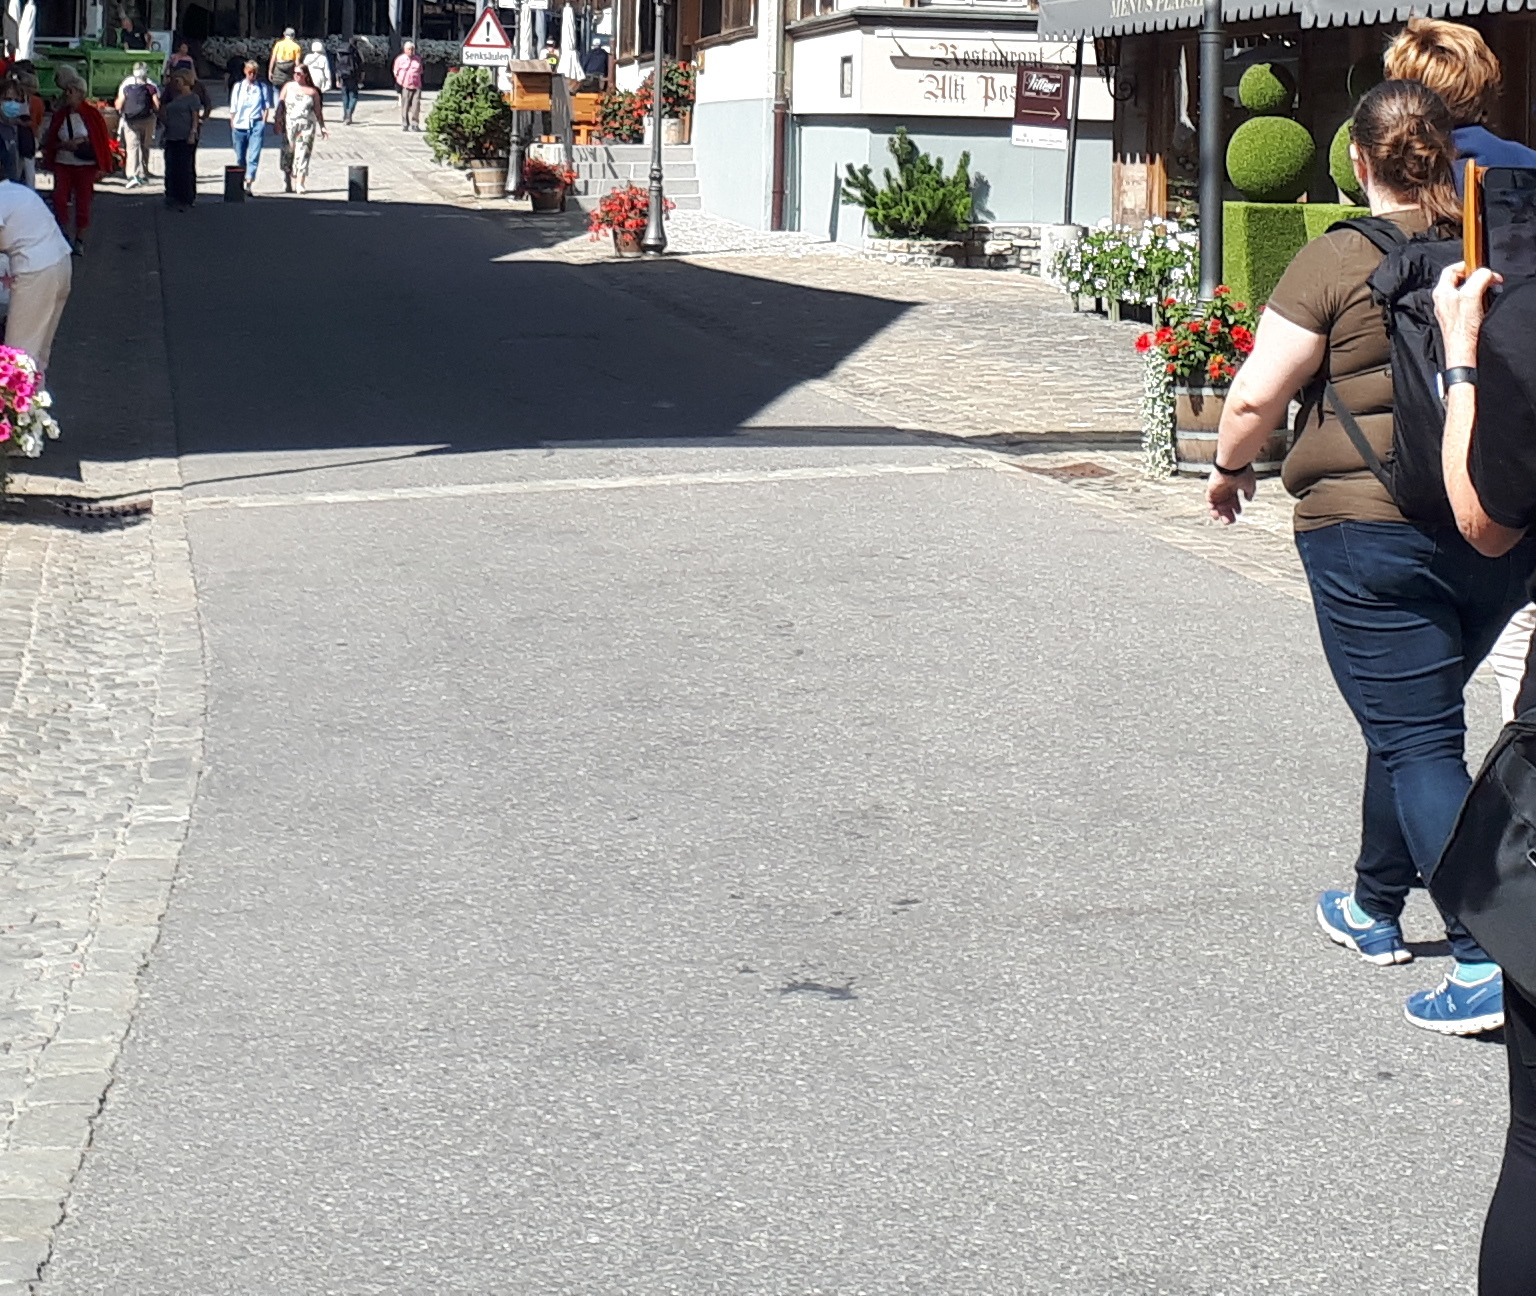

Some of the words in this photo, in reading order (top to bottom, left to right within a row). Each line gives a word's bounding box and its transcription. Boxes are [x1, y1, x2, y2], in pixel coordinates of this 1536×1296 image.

[465, 50, 510, 62] Senksäulen
[929, 42, 1045, 69] Restaurant
[977, 74, 1018, 113] Pos
